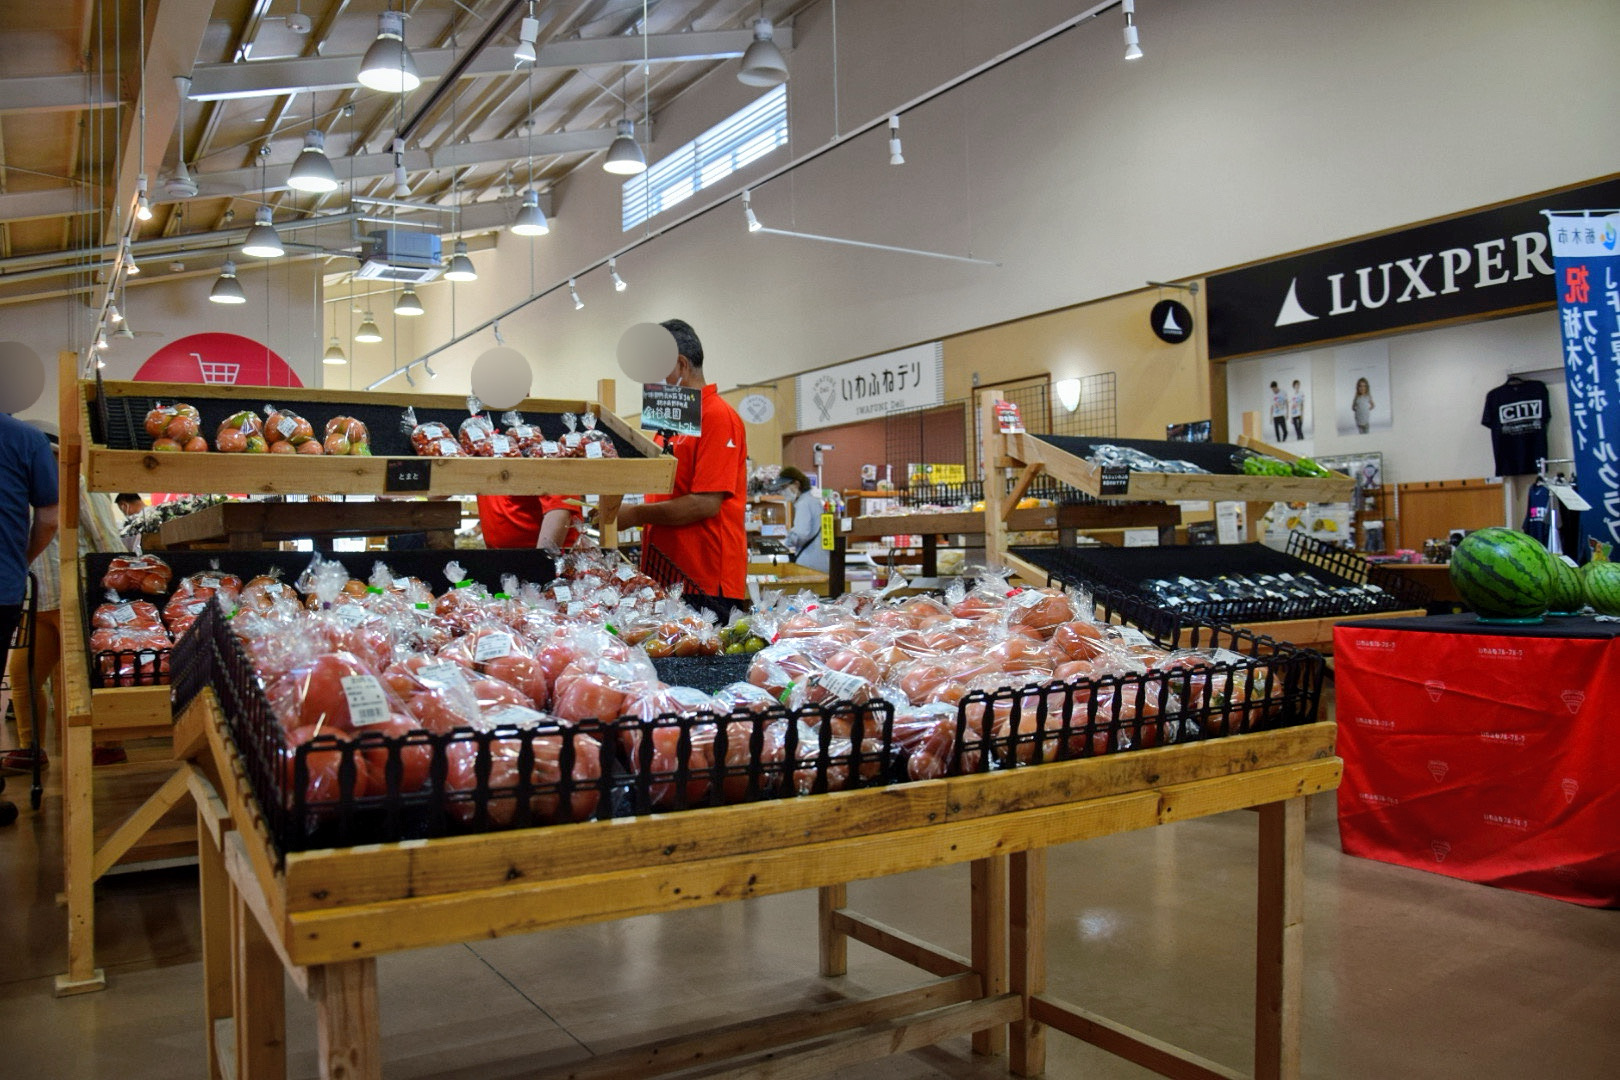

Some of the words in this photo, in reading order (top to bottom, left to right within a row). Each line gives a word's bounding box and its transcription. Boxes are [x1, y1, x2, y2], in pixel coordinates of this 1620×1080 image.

[841, 361, 921, 401] いわふねデリ
[1502, 403, 1539, 420] CITY
